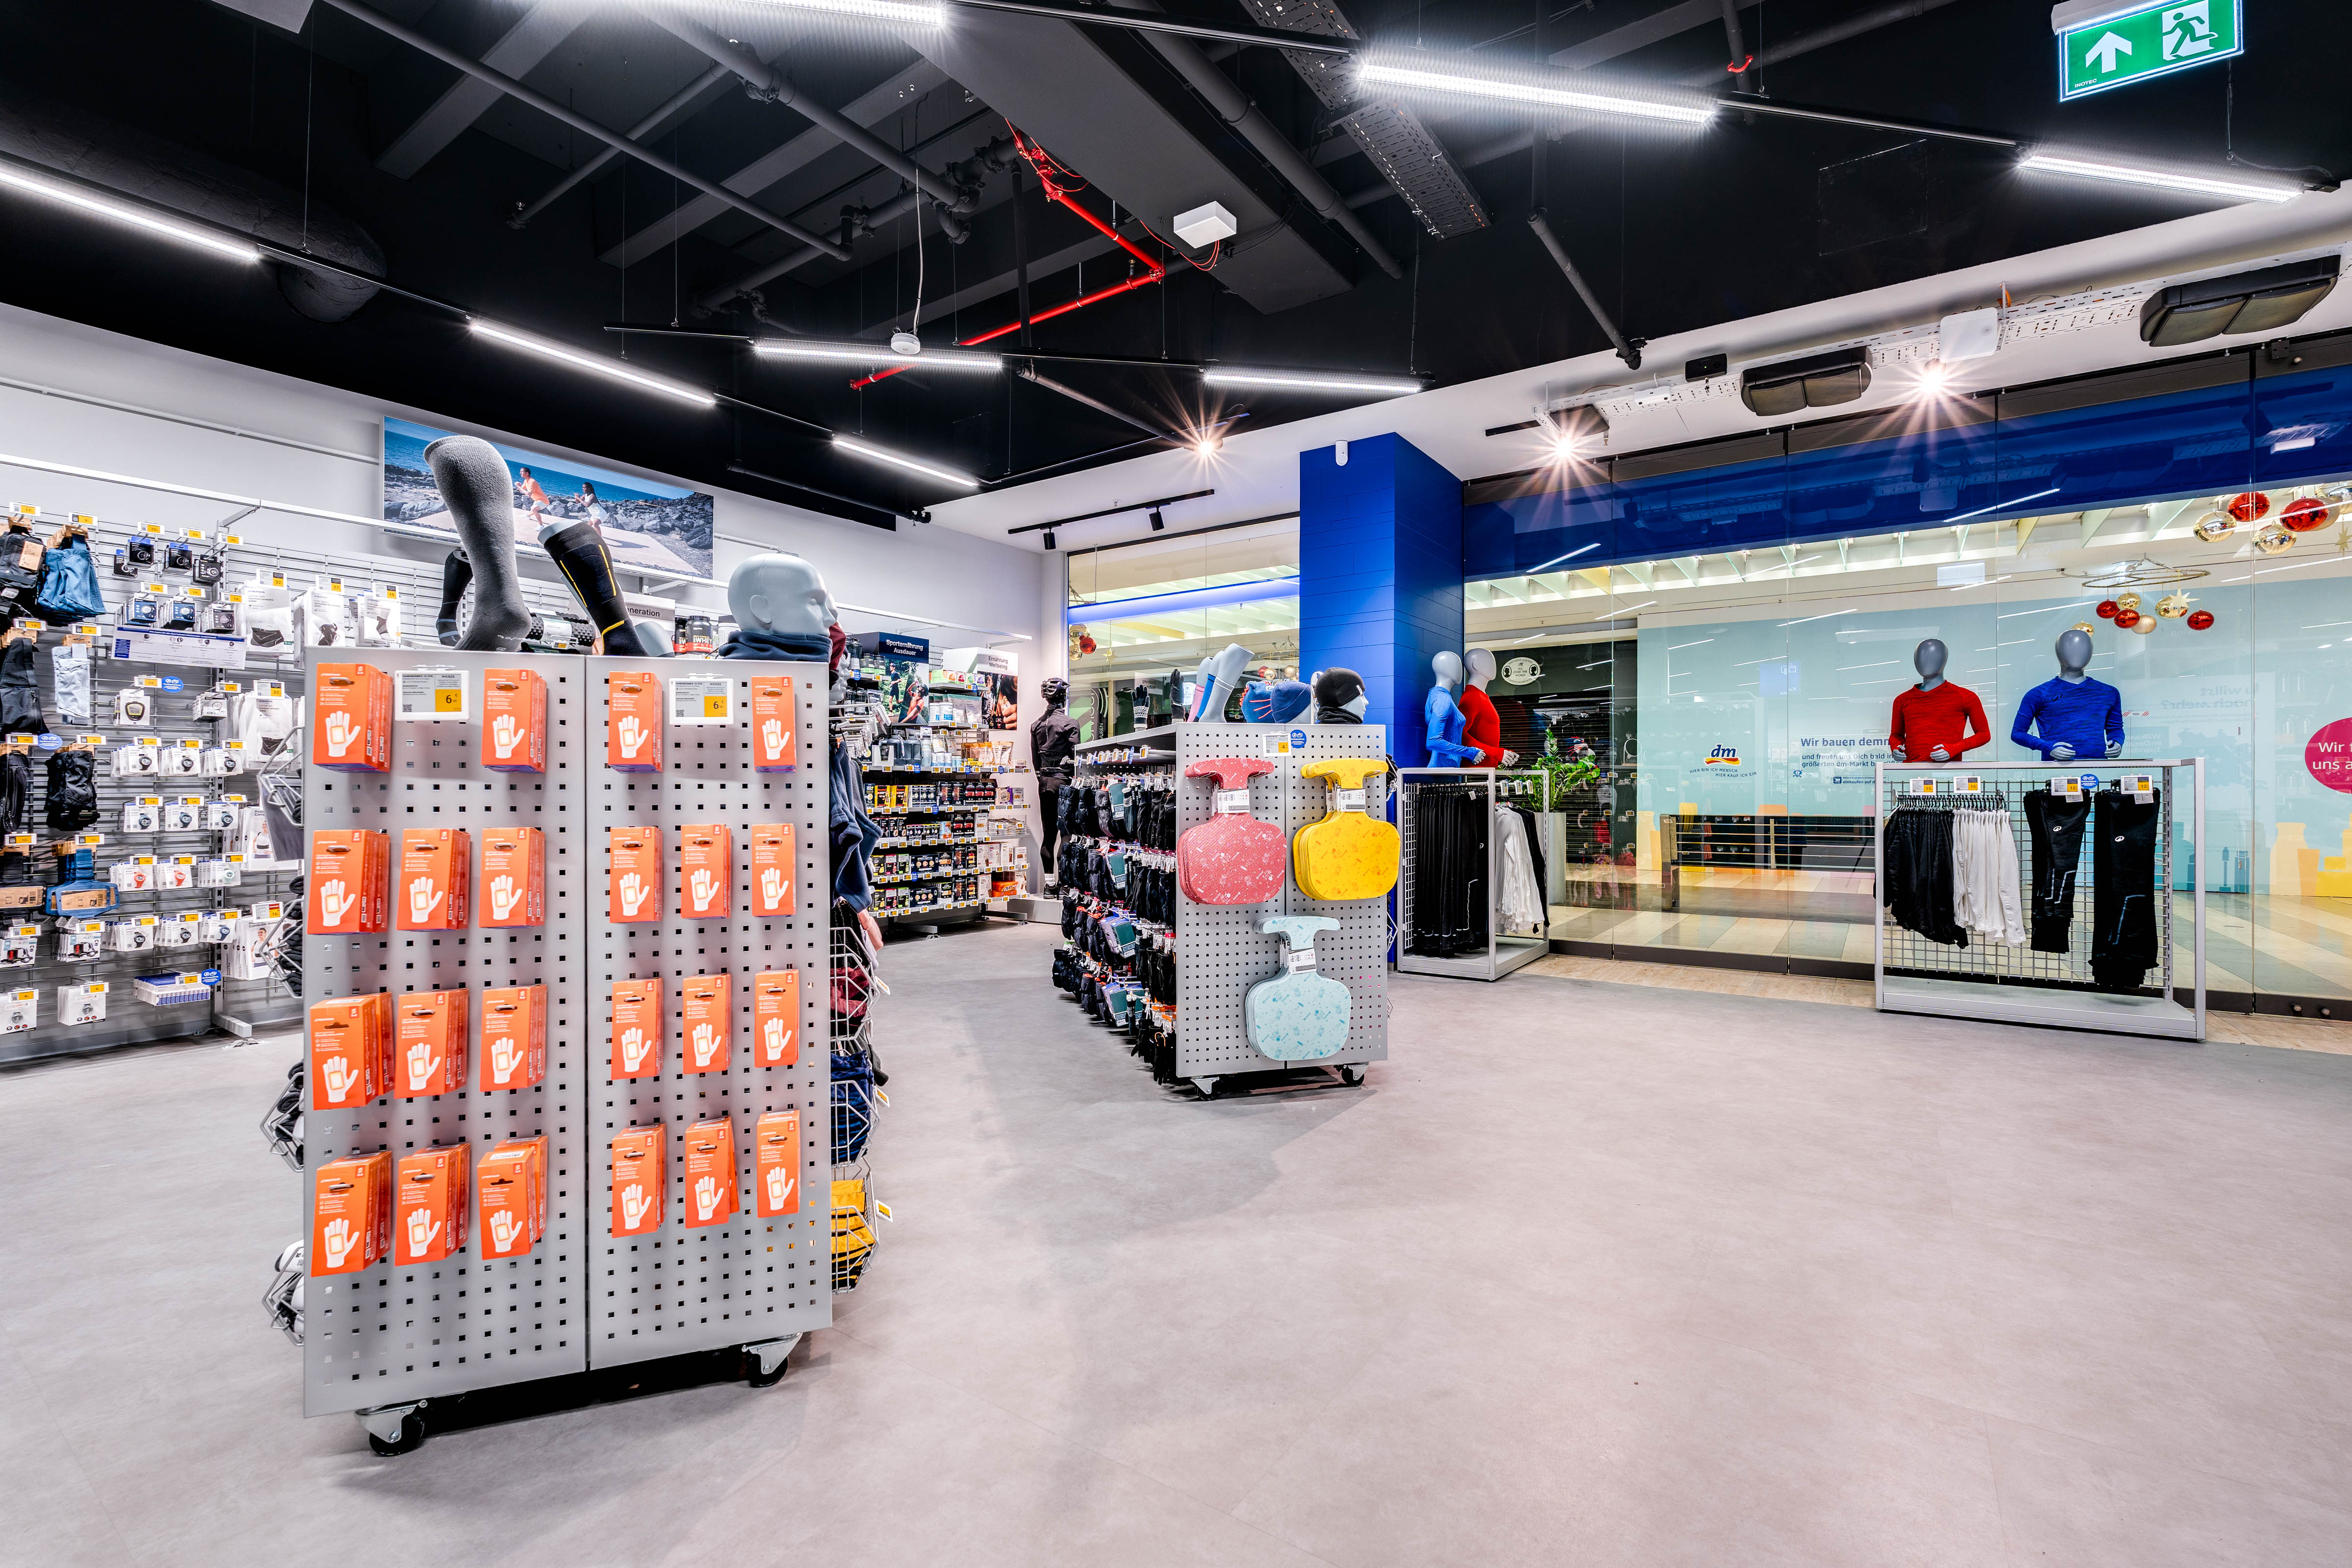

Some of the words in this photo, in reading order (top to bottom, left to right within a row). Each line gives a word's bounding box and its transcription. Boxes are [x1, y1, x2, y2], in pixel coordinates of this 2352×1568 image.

[2074, 78, 2097, 88] INOTEC
[627, 607, 660, 617] eneration
[886, 639, 923, 651] Sporternährung
[988, 656, 1008, 664] Ernährung
[446, 695, 452, 704] 6
[713, 701, 719, 709] 6
[1801, 738, 1819, 746] Wir
[1822, 737, 1855, 746] bauen
[1711, 744, 1736, 758] dm
[2318, 742, 2345, 753] Wir
[2312, 761, 2340, 770] uns
